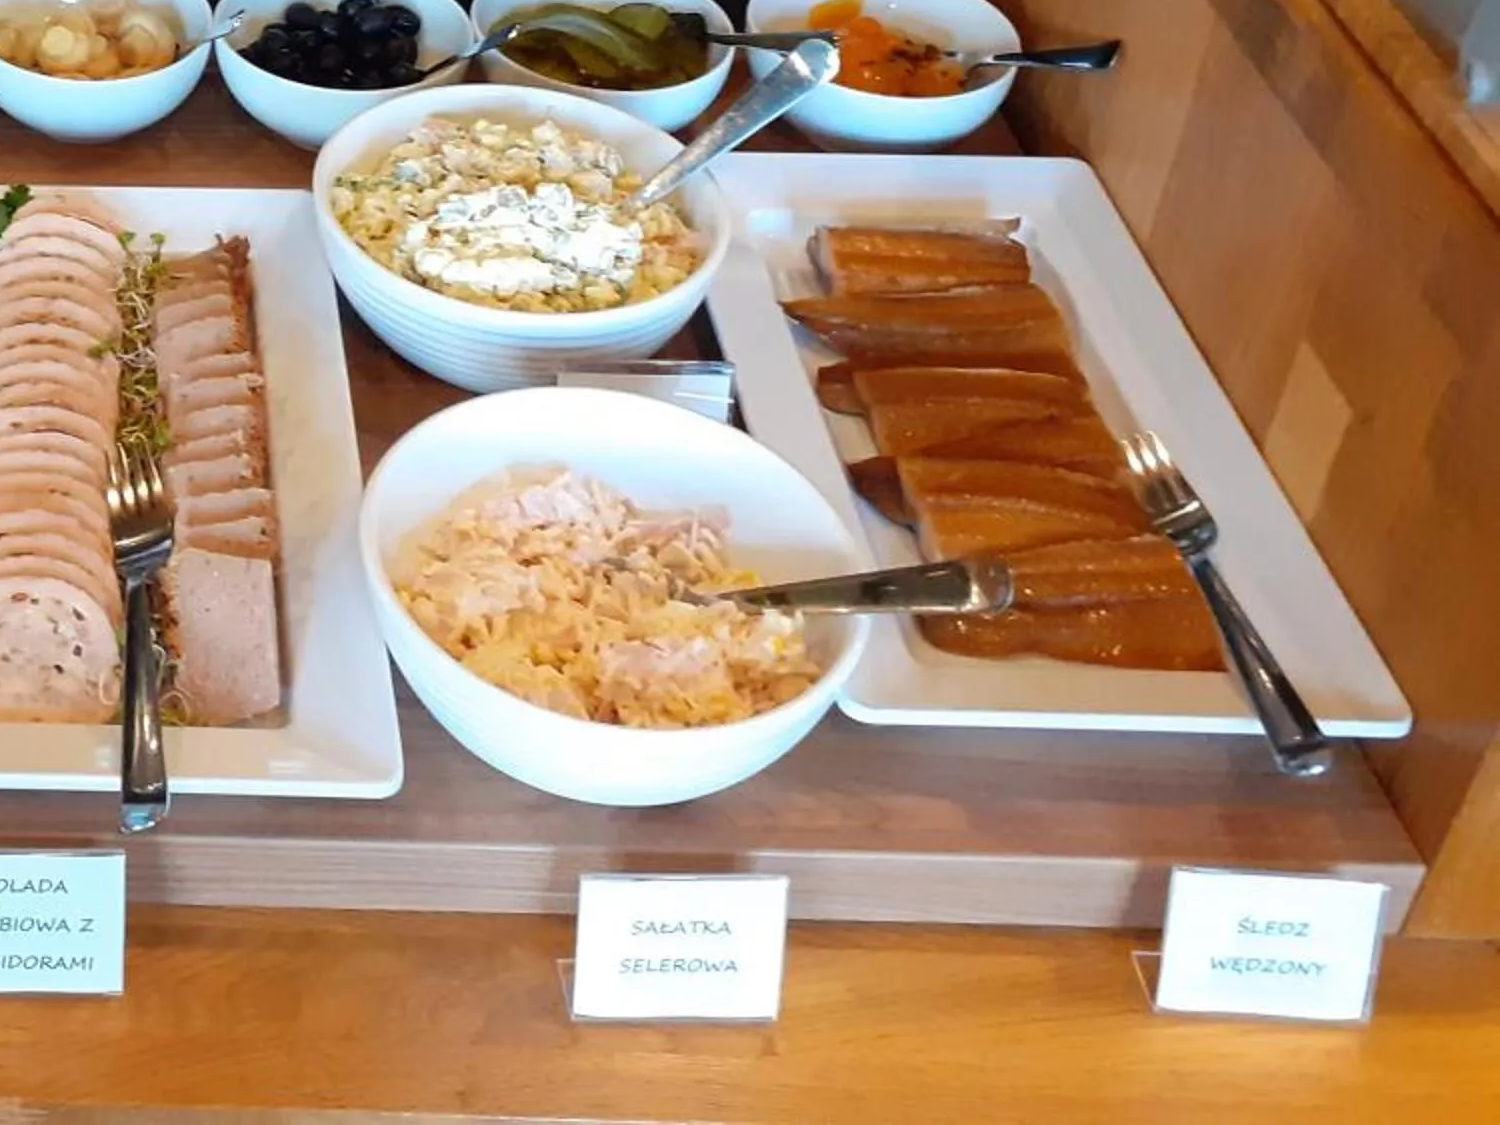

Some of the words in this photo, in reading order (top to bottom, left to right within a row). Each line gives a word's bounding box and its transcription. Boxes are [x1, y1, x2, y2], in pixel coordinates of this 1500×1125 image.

[79, 918, 95, 933] Z
[631, 920, 732, 936] SAŁATKA
[618, 958, 740, 974] SELEROWA
[1209, 956, 1329, 979] WĘDZONY
